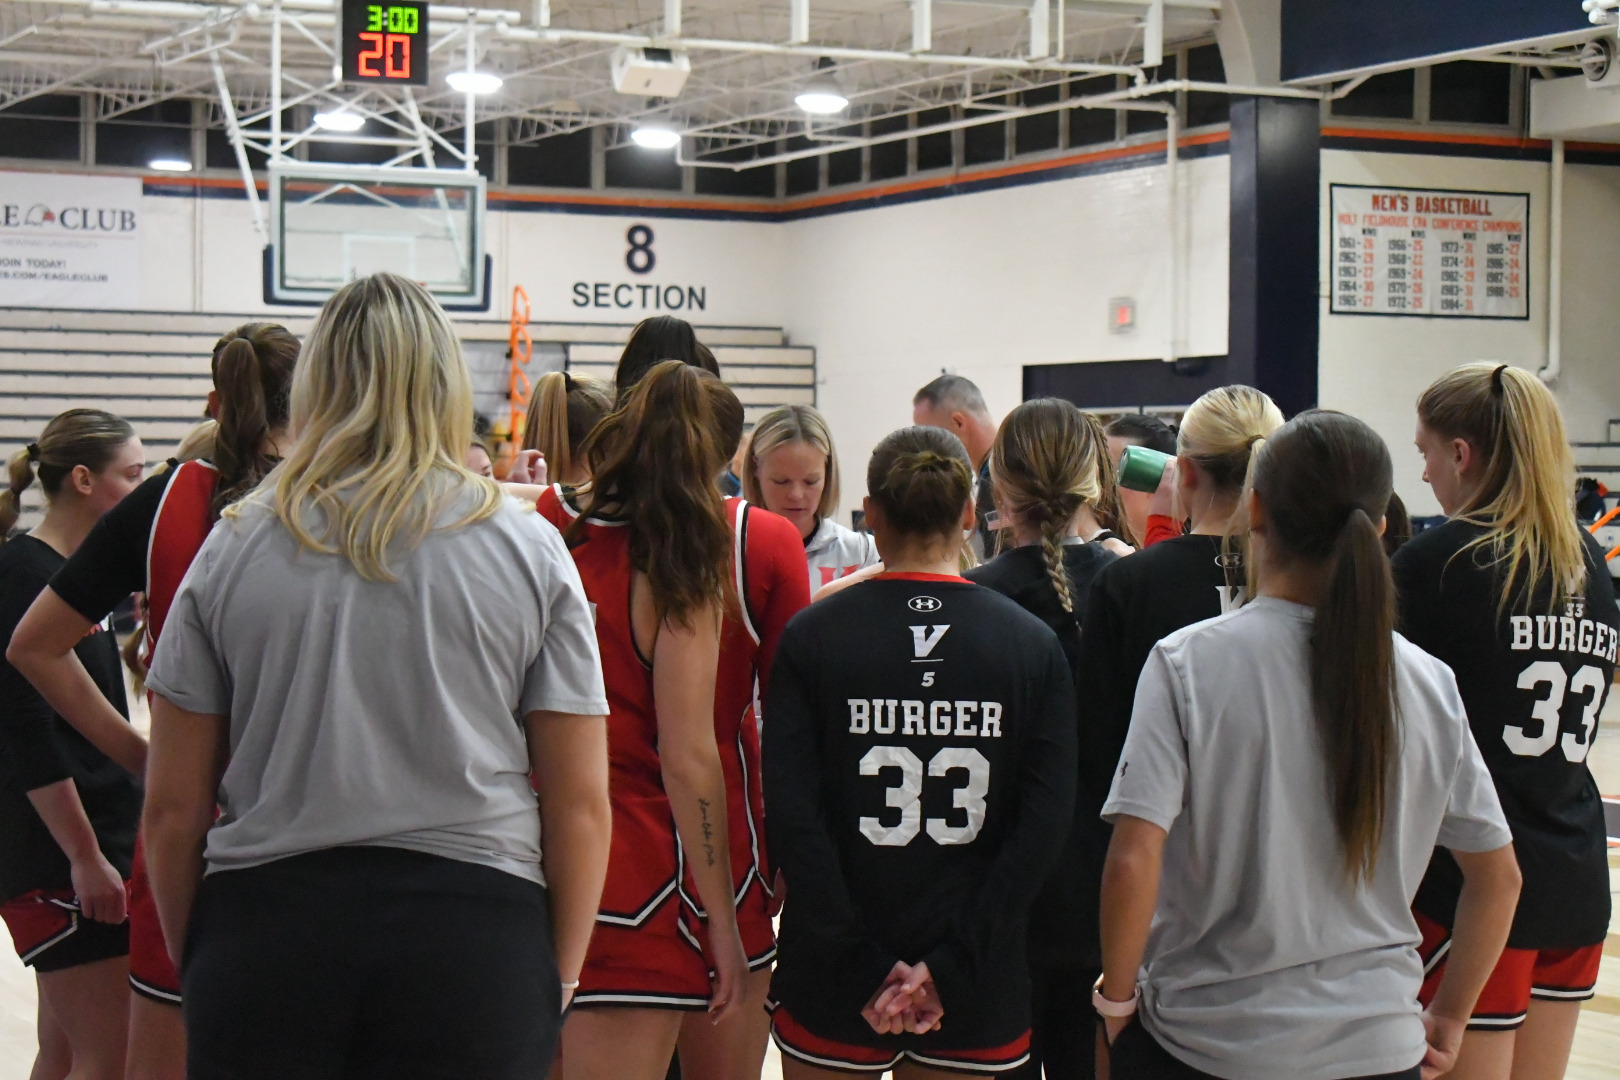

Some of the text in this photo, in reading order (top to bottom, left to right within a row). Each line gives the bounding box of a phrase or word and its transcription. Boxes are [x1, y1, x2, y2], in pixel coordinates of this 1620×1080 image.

[366, 5, 419, 34] 3:00
[358, 32, 411, 78] 20
[60, 207, 136, 231] CLUB
[1372, 194, 1492, 216] MEN'S BASKETBALL
[27, 259, 66, 268] TODAY!
[626, 224, 656, 274] 8
[573, 282, 706, 310] SECTION
[908, 624, 951, 658] V
[1510, 615, 1618, 663] BURGER
[921, 671, 936, 687] 5
[847, 698, 1003, 737] BURGER
[1502, 660, 1606, 763] 33
[859, 745, 990, 847] 33
